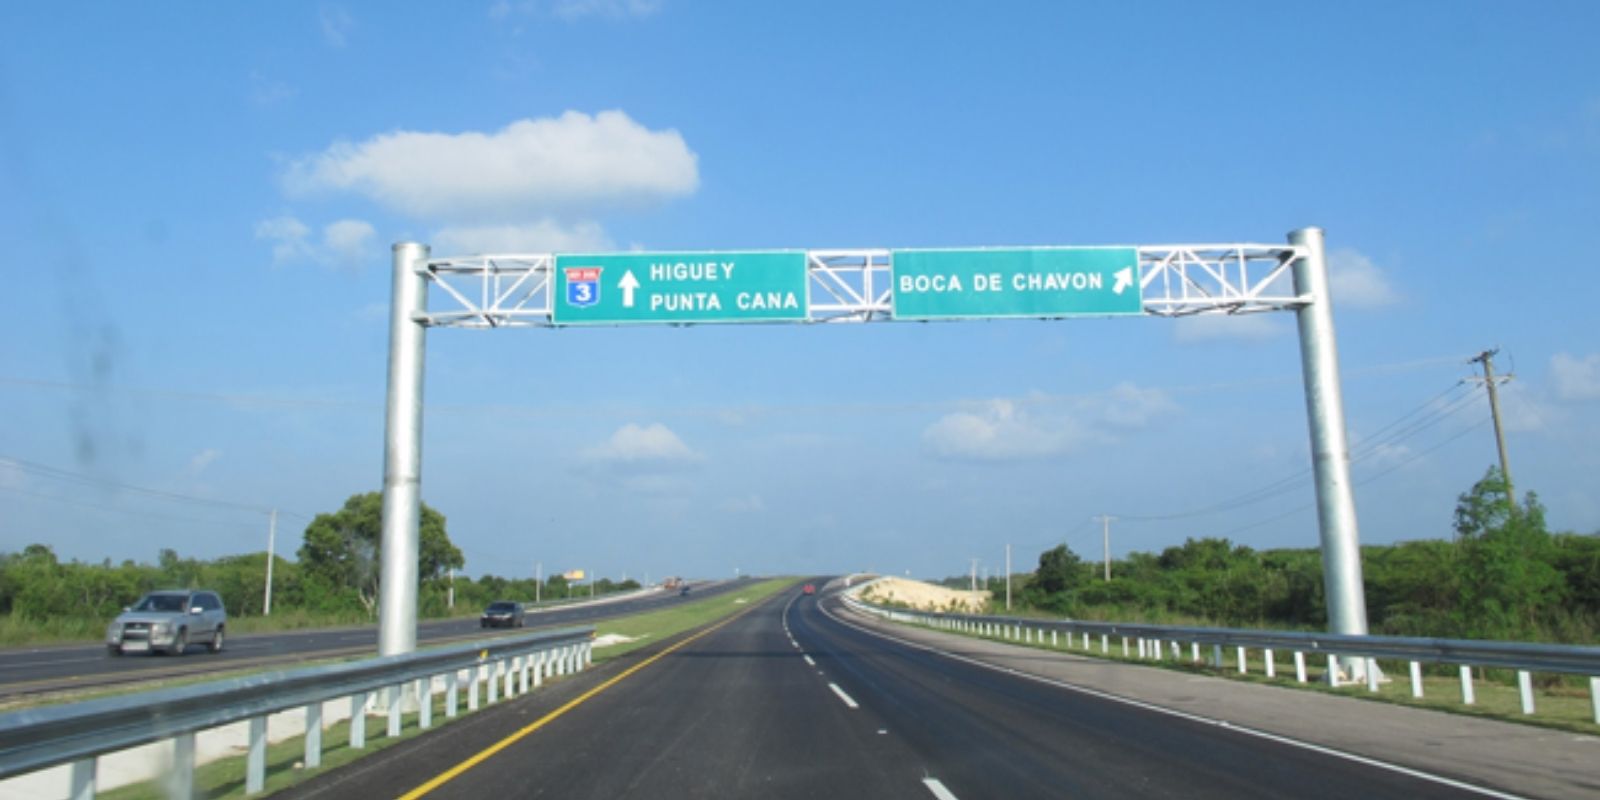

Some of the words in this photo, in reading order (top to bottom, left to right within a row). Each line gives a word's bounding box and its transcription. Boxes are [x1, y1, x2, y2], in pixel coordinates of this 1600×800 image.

[651, 262, 735, 281] HIGUEY
[899, 274, 963, 292] BOCA
[974, 273, 1003, 291] DE
[1012, 272, 1103, 291] CHAVON
[575, 283, 592, 301] 3
[651, 293, 722, 311] PUNTA
[736, 291, 799, 310] CANA
